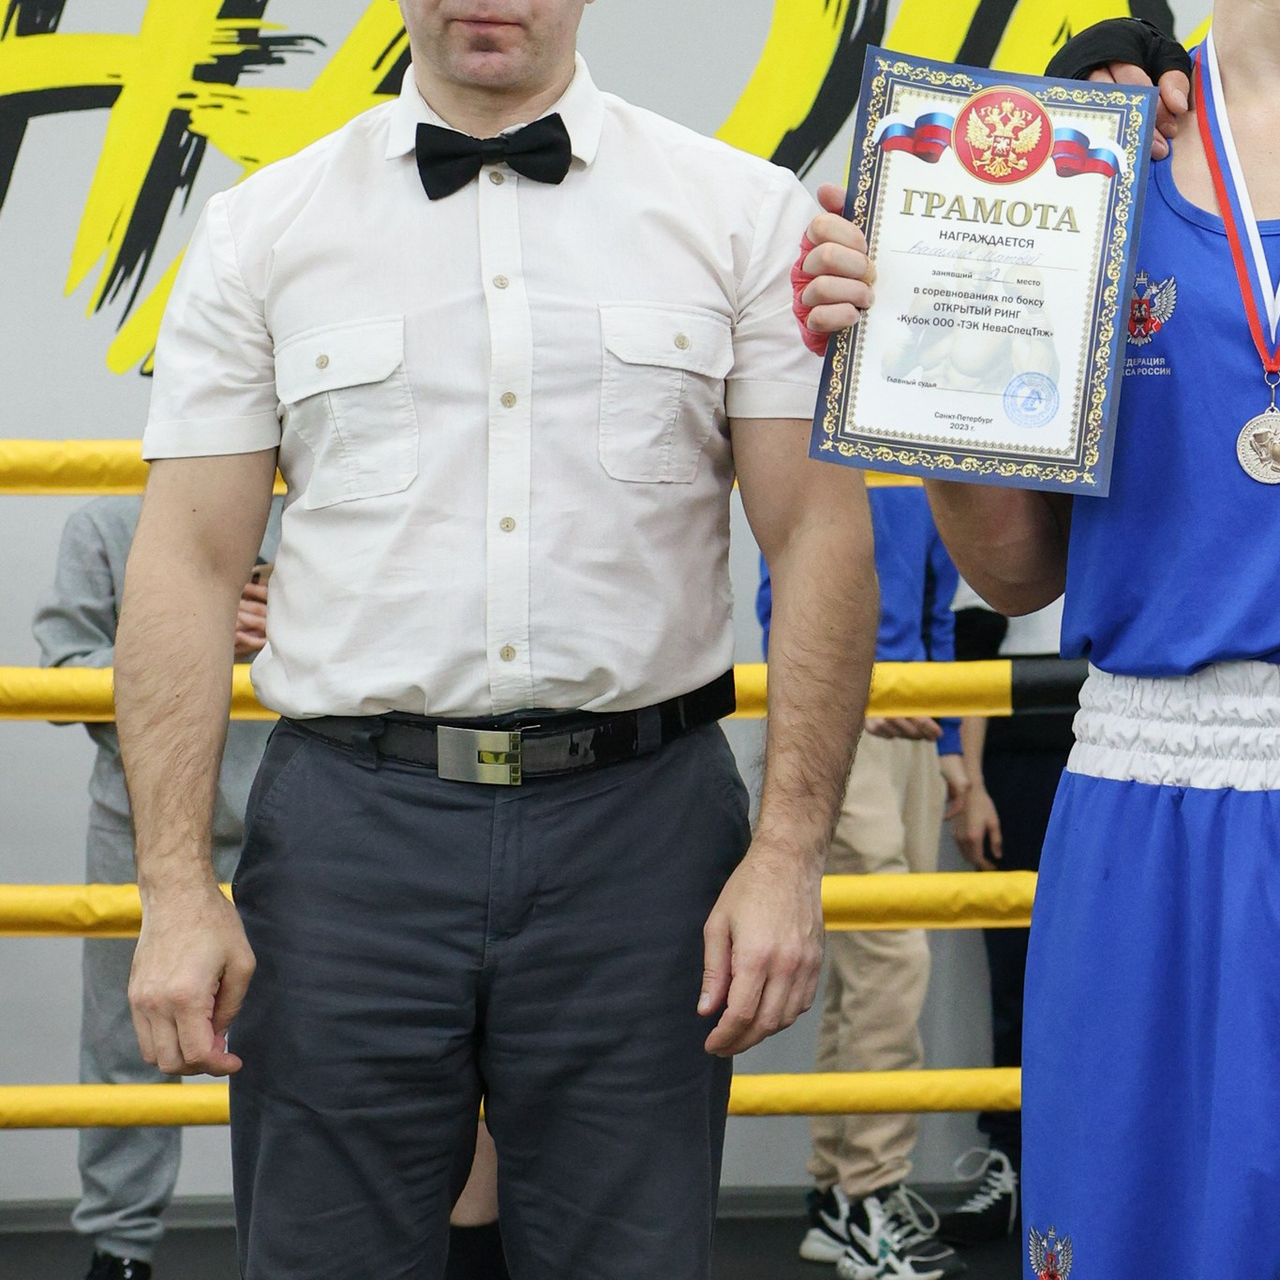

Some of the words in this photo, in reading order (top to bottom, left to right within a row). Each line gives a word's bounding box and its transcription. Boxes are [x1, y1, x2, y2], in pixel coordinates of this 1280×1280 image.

[899, 188, 1081, 233] ГРАМОТА
[938, 230, 1035, 249] НАГРАЖДАЕТСЯ
[931, 269, 973, 280] занявший
[1016, 278, 1041, 287] место
[913, 286, 920, 294] в
[922, 288, 999, 303] соревнованиях
[1001, 296, 1014, 304] по
[1016, 295, 1045, 308] боксу
[933, 301, 992, 316] ОТКРЫТЫЙ
[994, 309, 1022, 319] РИНГ
[932, 317, 955, 328] ООО
[1123, 357, 1166, 367] ЕДЕРАЦИЯ
[886, 375, 916, 386] Главный
[917, 380, 937, 389] судья
[934, 411, 993, 424] Санкт-Петербург
[949, 422, 969, 431] 2023
